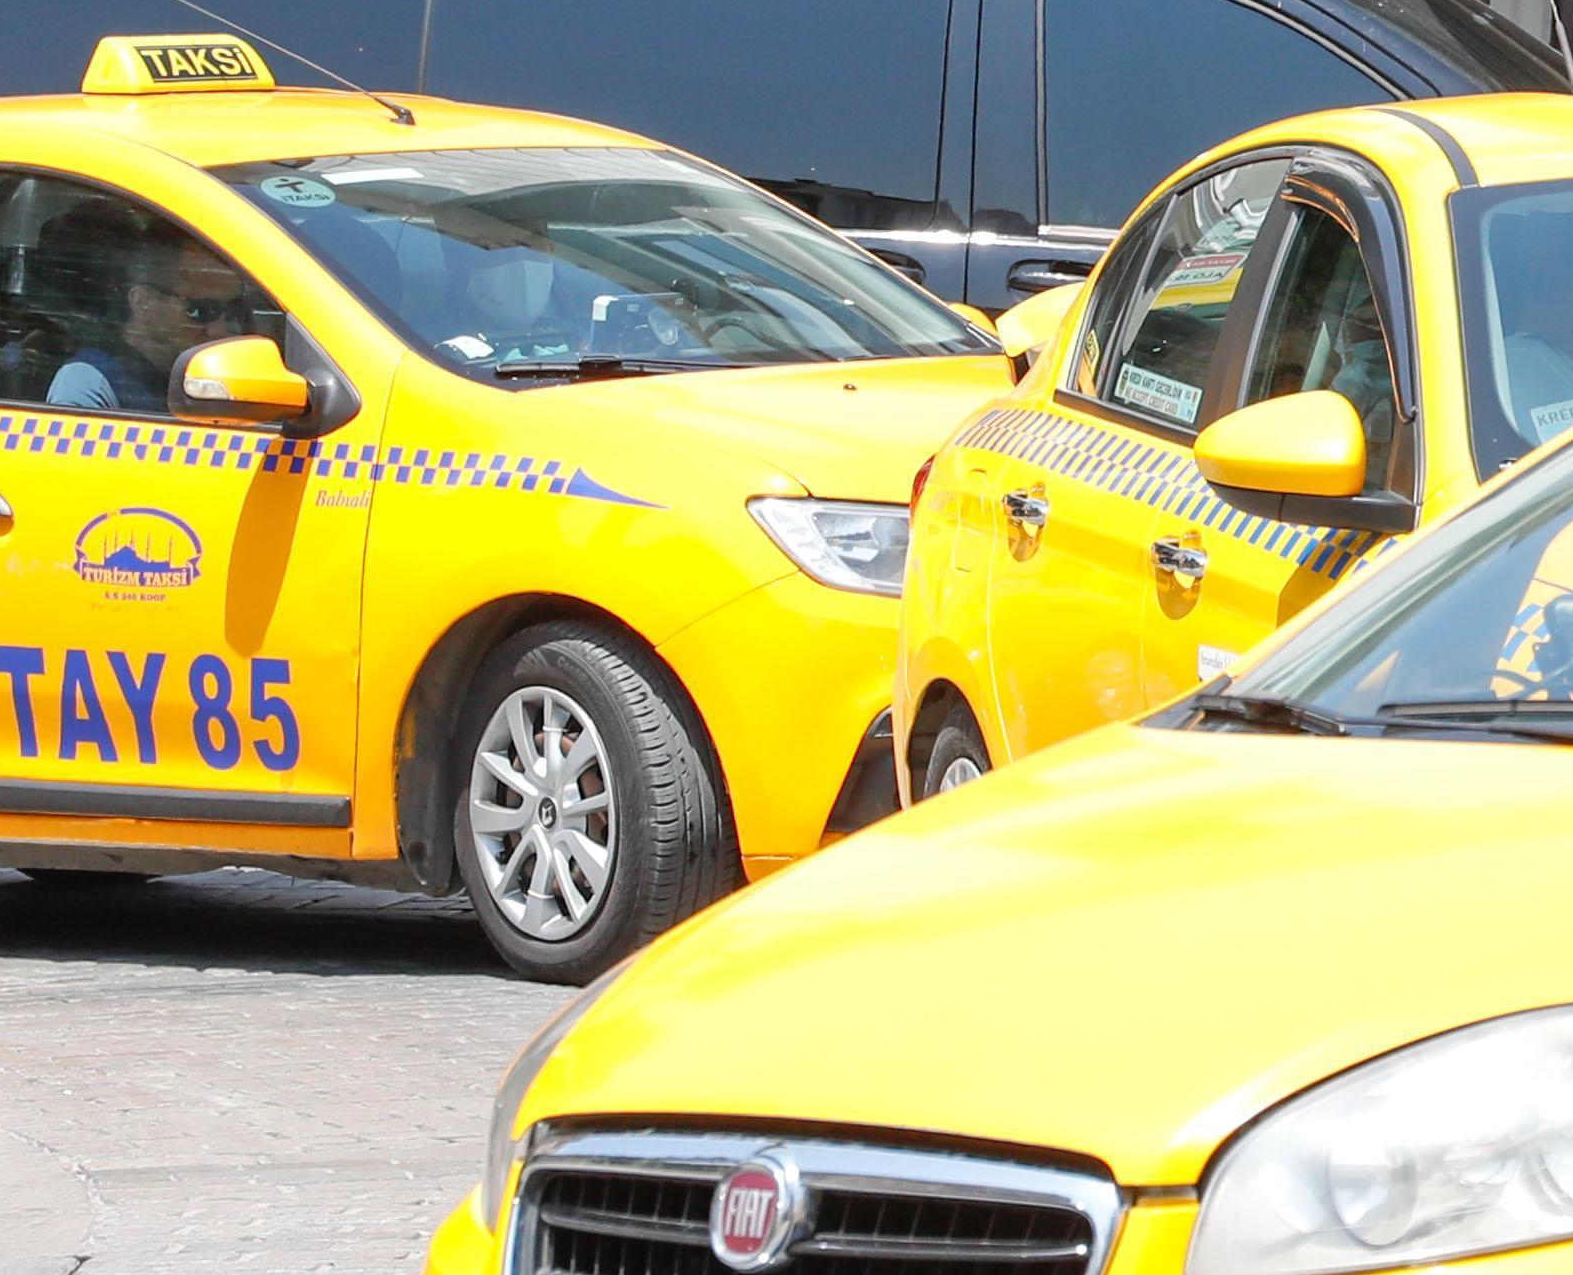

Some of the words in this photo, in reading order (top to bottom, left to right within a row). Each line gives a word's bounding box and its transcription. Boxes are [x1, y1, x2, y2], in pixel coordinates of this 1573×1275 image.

[83, 566, 141, 587] TURİZM
[143, 567, 188, 588] TAKSİ
[188, 653, 301, 772] 85
[725, 1187, 774, 1239] FIAT
